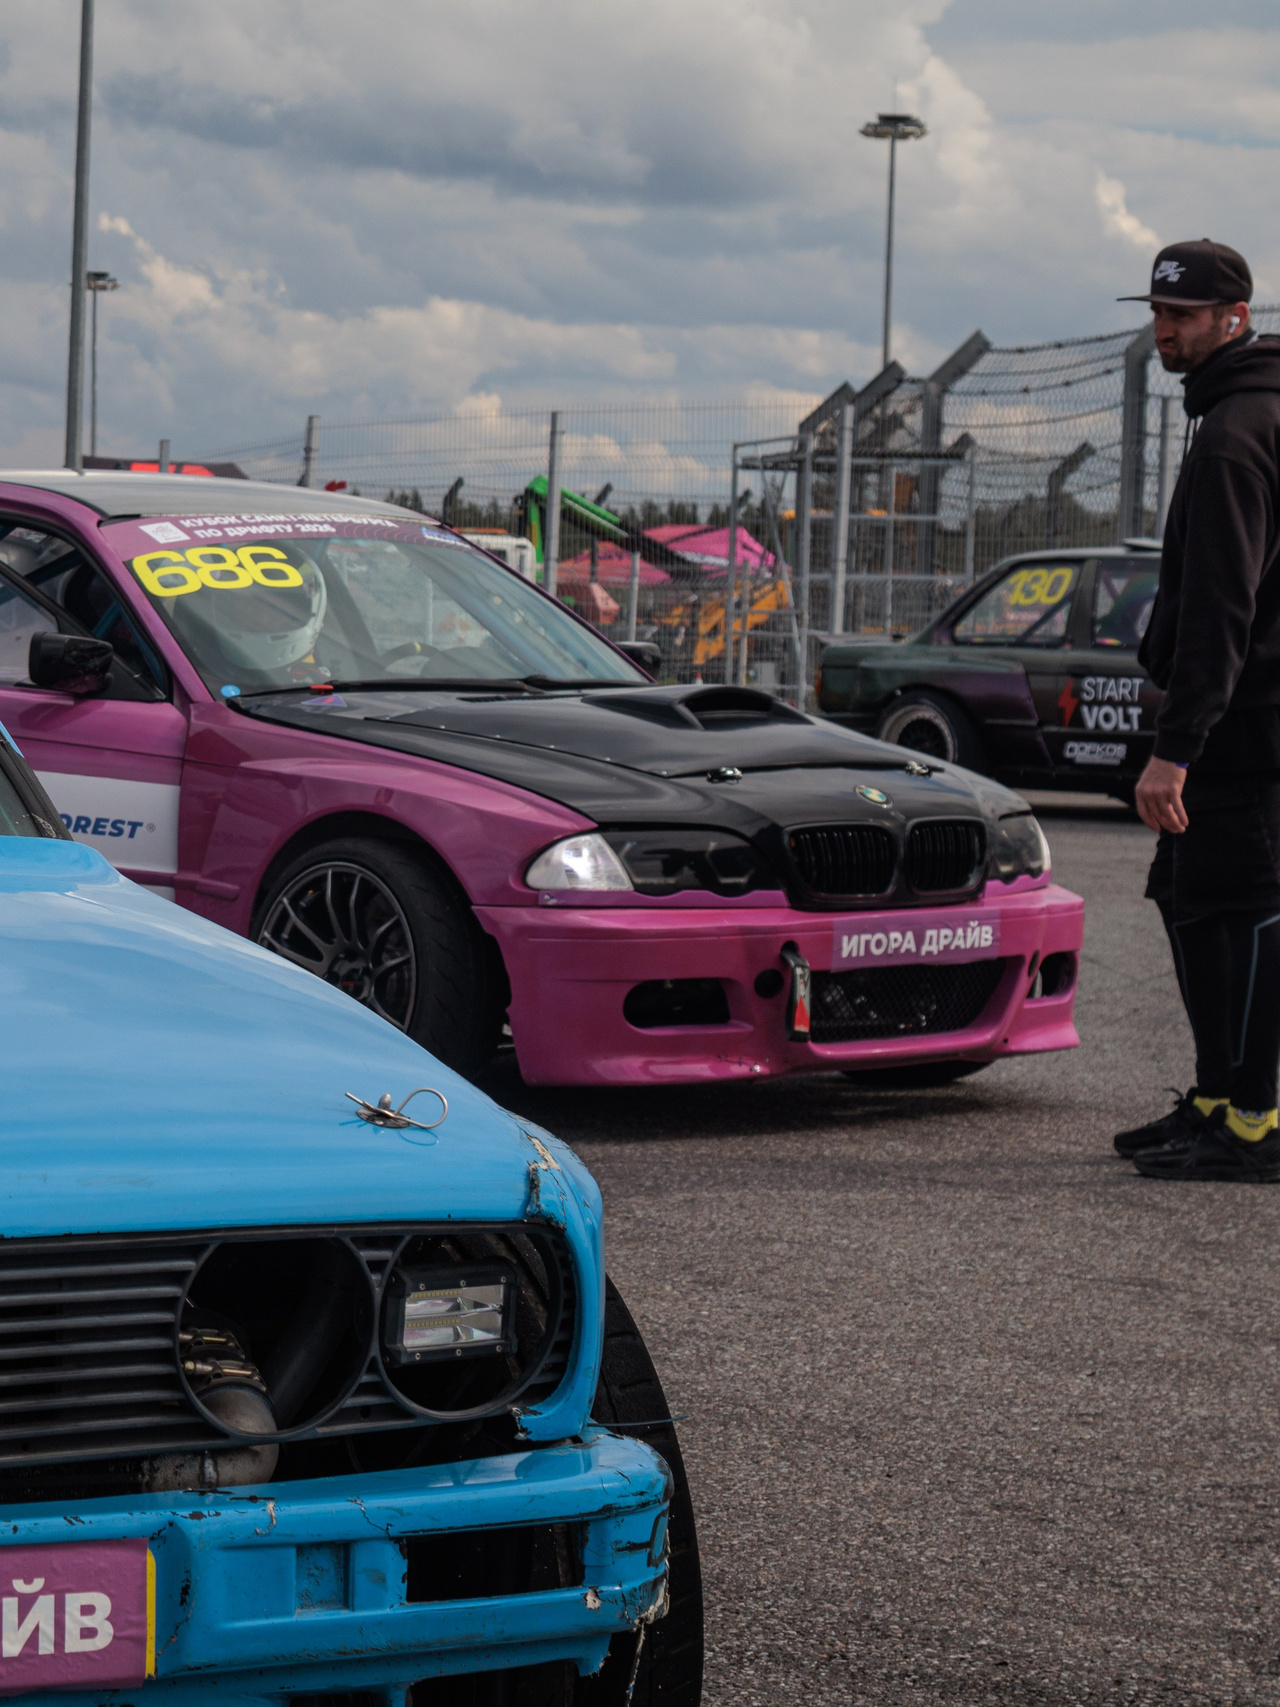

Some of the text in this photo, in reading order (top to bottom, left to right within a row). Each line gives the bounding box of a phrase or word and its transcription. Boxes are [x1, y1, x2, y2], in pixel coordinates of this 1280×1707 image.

[132, 545, 304, 597] 686
[1009, 567, 1073, 606] 130
[1081, 676, 1145, 702] START
[1081, 704, 1142, 732] VOLT
[841, 920, 993, 958] ИГОРА ДРАЙВ
